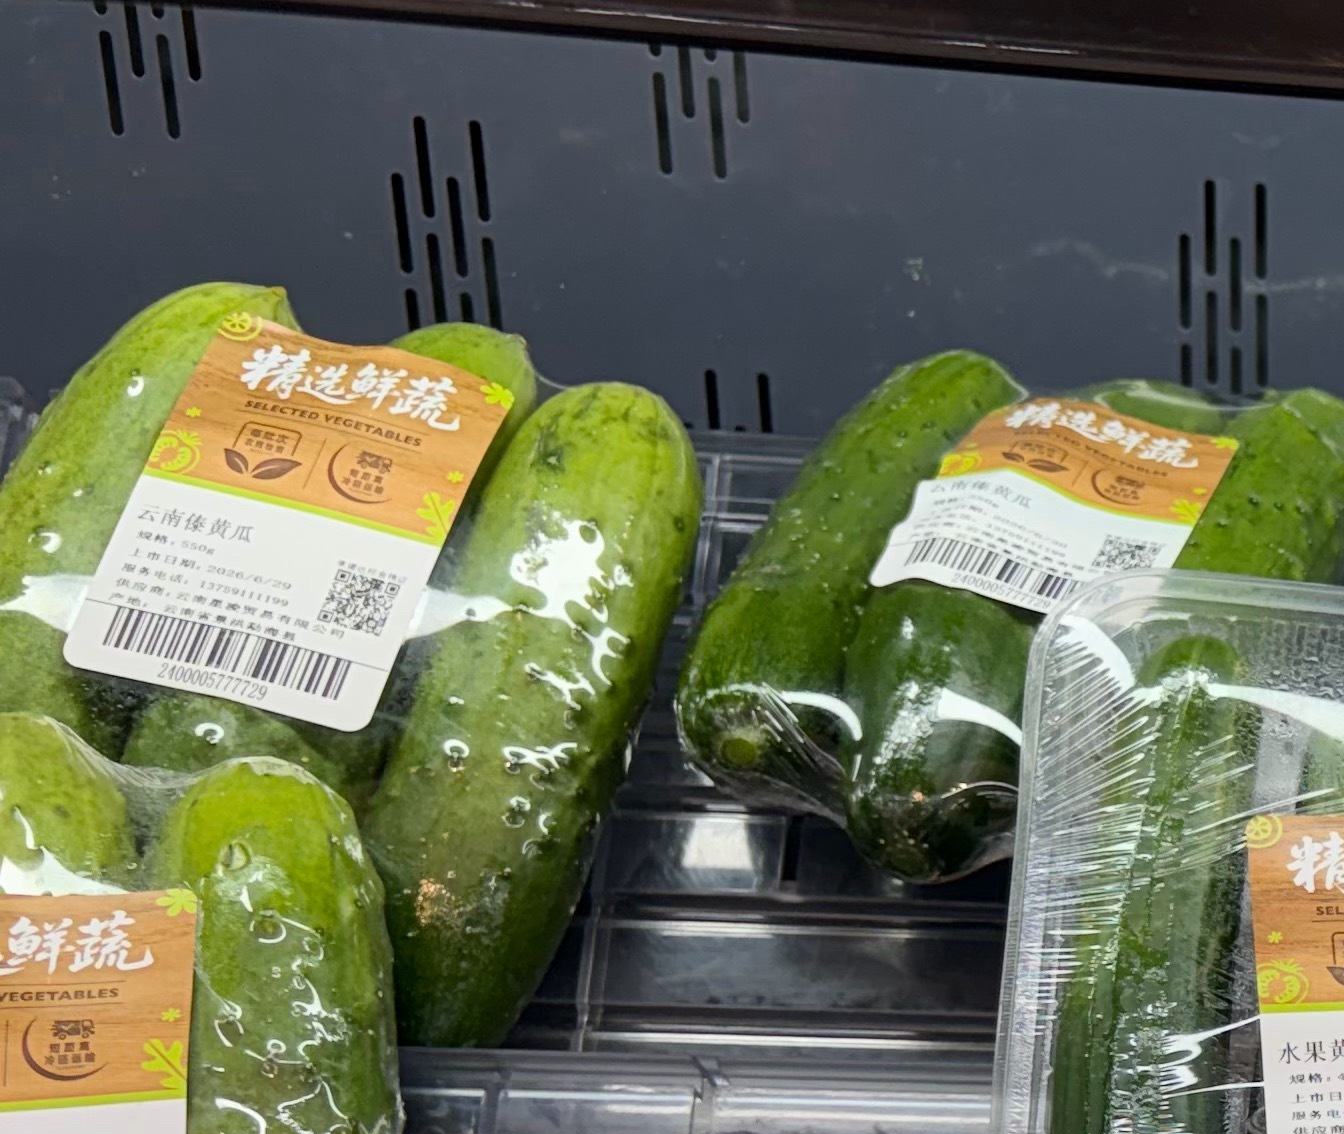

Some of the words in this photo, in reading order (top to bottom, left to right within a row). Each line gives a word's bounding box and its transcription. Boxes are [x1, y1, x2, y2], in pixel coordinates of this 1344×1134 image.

[240, 344, 461, 431] 精选鲜蔬
[244, 400, 320, 420] SELECTED
[324, 414, 423, 447] VEGETABLES
[1005, 401, 1199, 468] 精选鲜蔬
[137, 503, 254, 543] 云南傣黄瓜
[157, 662, 268, 701] 2400005777729
[0, 909, 155, 975] 鲜蔬
